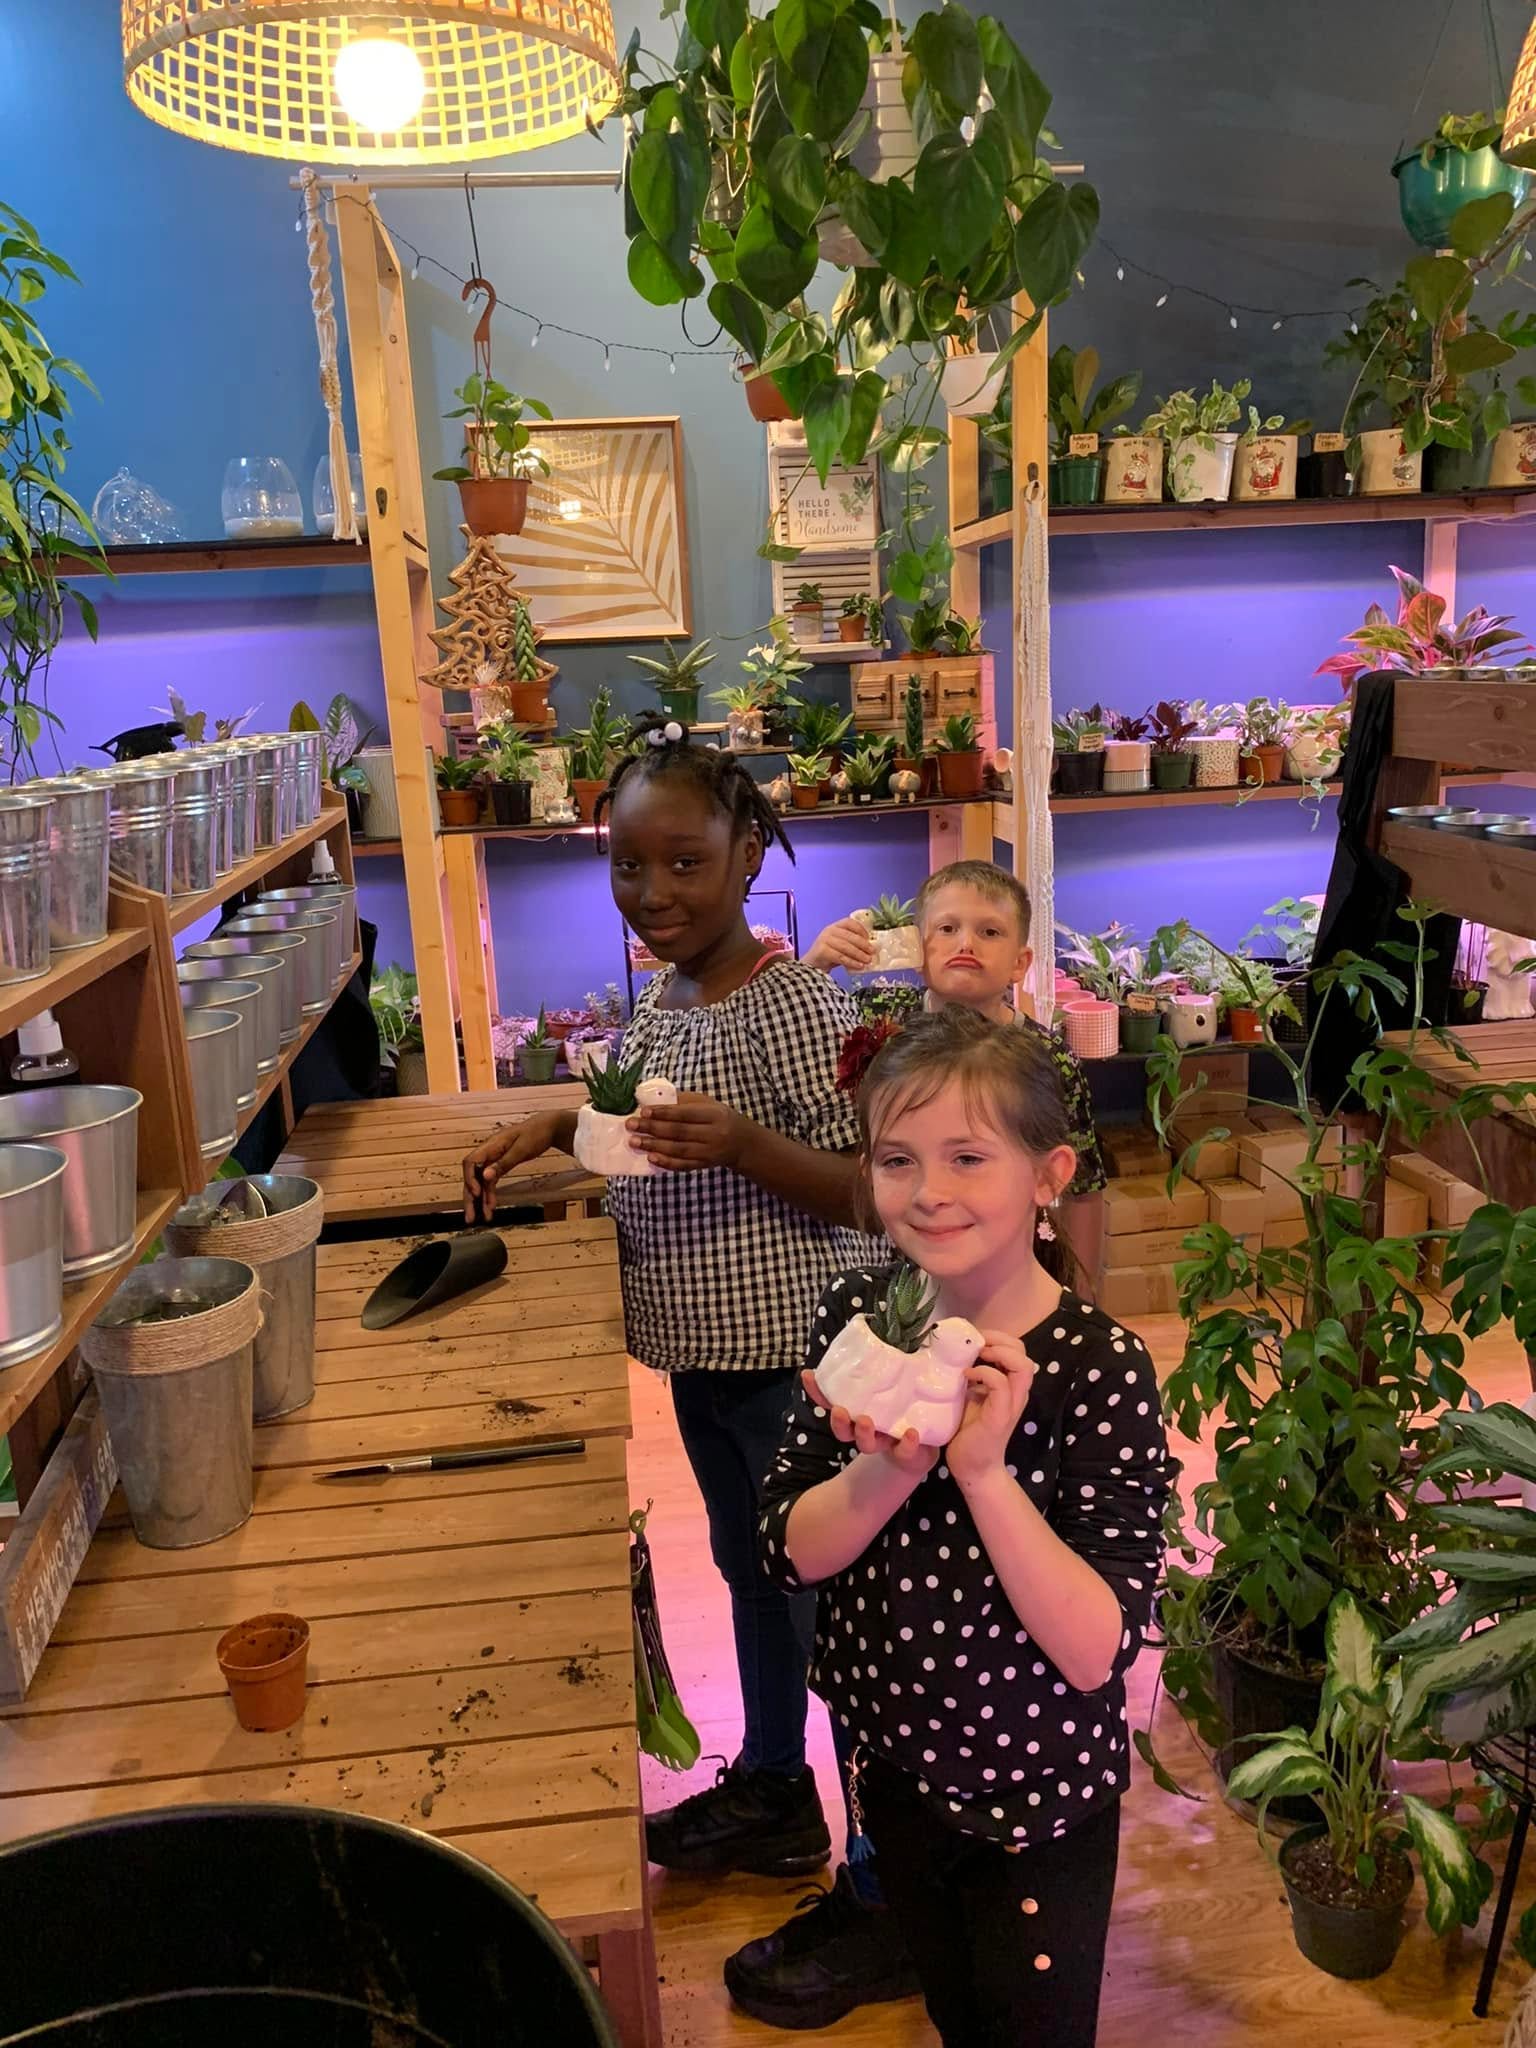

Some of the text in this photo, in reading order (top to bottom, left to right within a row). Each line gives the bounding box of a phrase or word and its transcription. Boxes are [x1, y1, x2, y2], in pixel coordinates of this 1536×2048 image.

[798, 498, 831, 508] HELLO
[793, 518, 857, 536] Handsome
[25, 1584, 44, 1633] HE
[40, 1539, 65, 1600] WHO
